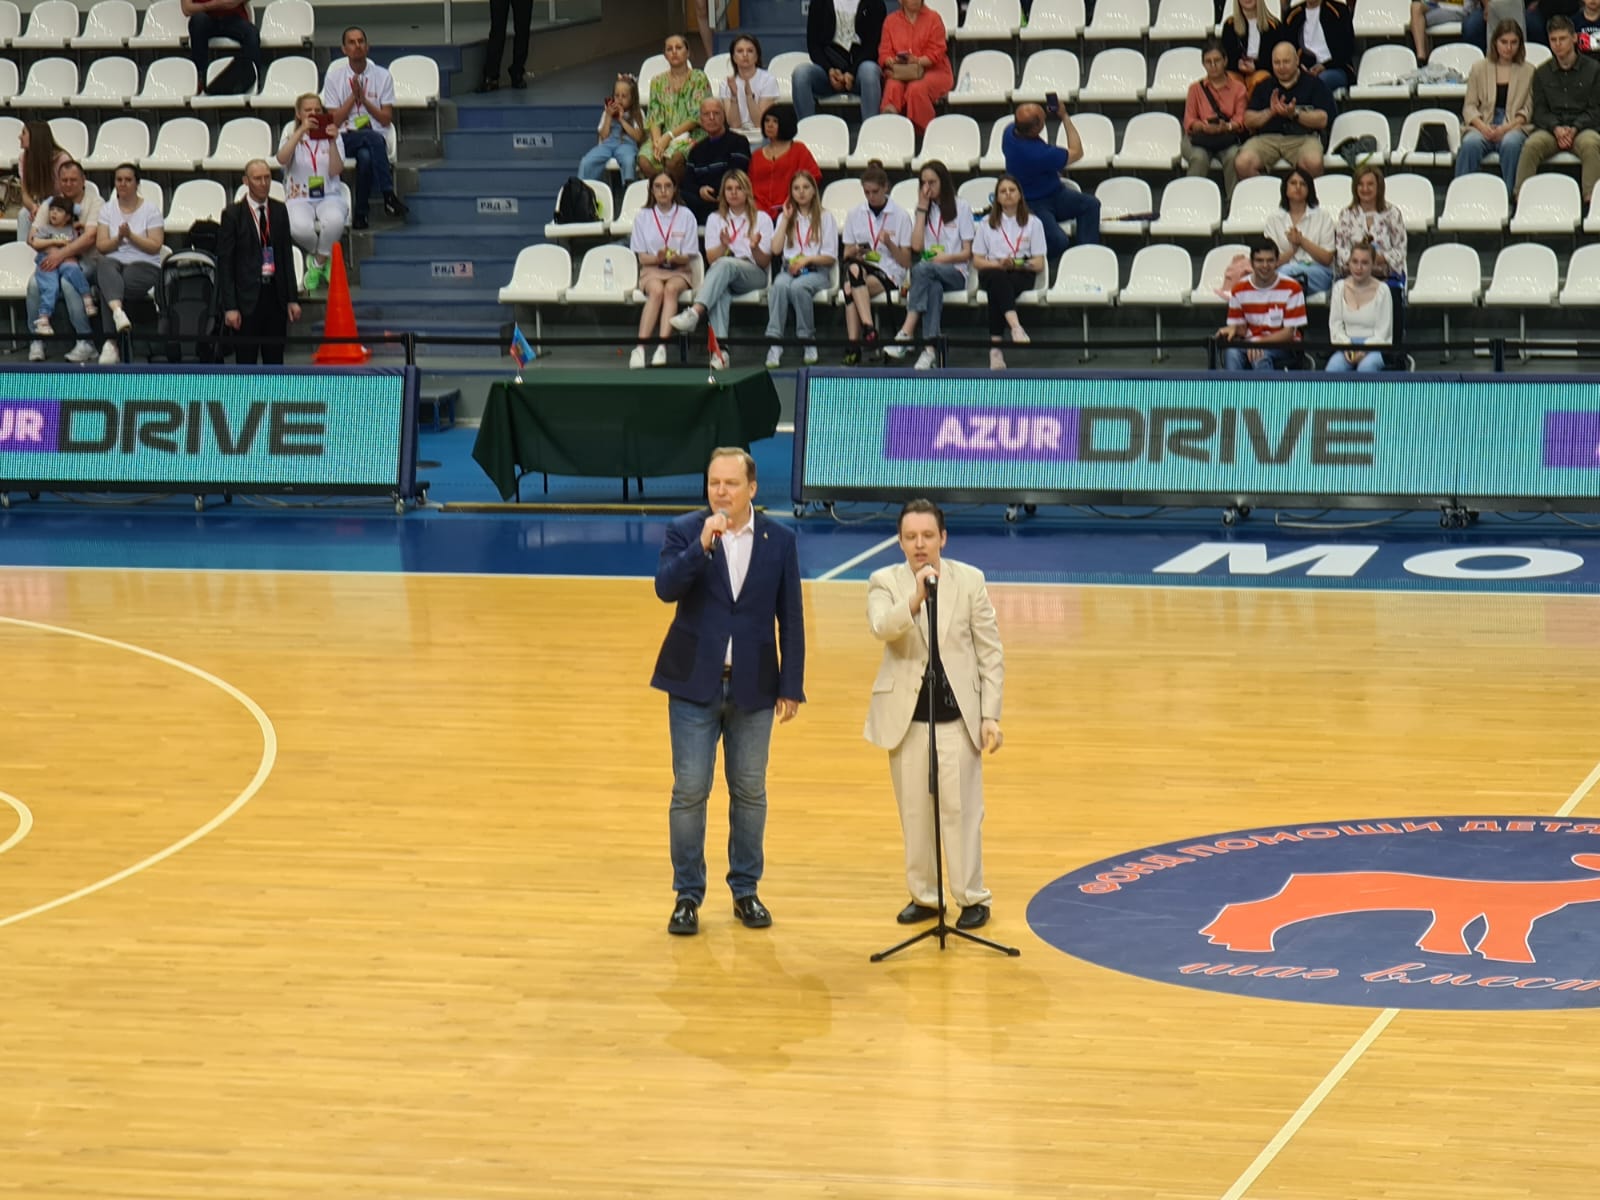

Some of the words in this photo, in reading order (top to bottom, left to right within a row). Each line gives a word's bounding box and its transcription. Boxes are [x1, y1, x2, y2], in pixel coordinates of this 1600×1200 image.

[540, 136, 546, 145] 4
[459, 263, 466, 272] 2
[58, 399, 327, 455] DRIVE
[933, 415, 1061, 451] AZUR
[1079, 407, 1375, 465] DRIVE
[1078, 853, 1197, 894] ФОНД
[1177, 820, 1443, 858] ПОМОЩИ
[1178, 962, 1340, 980] шаг
